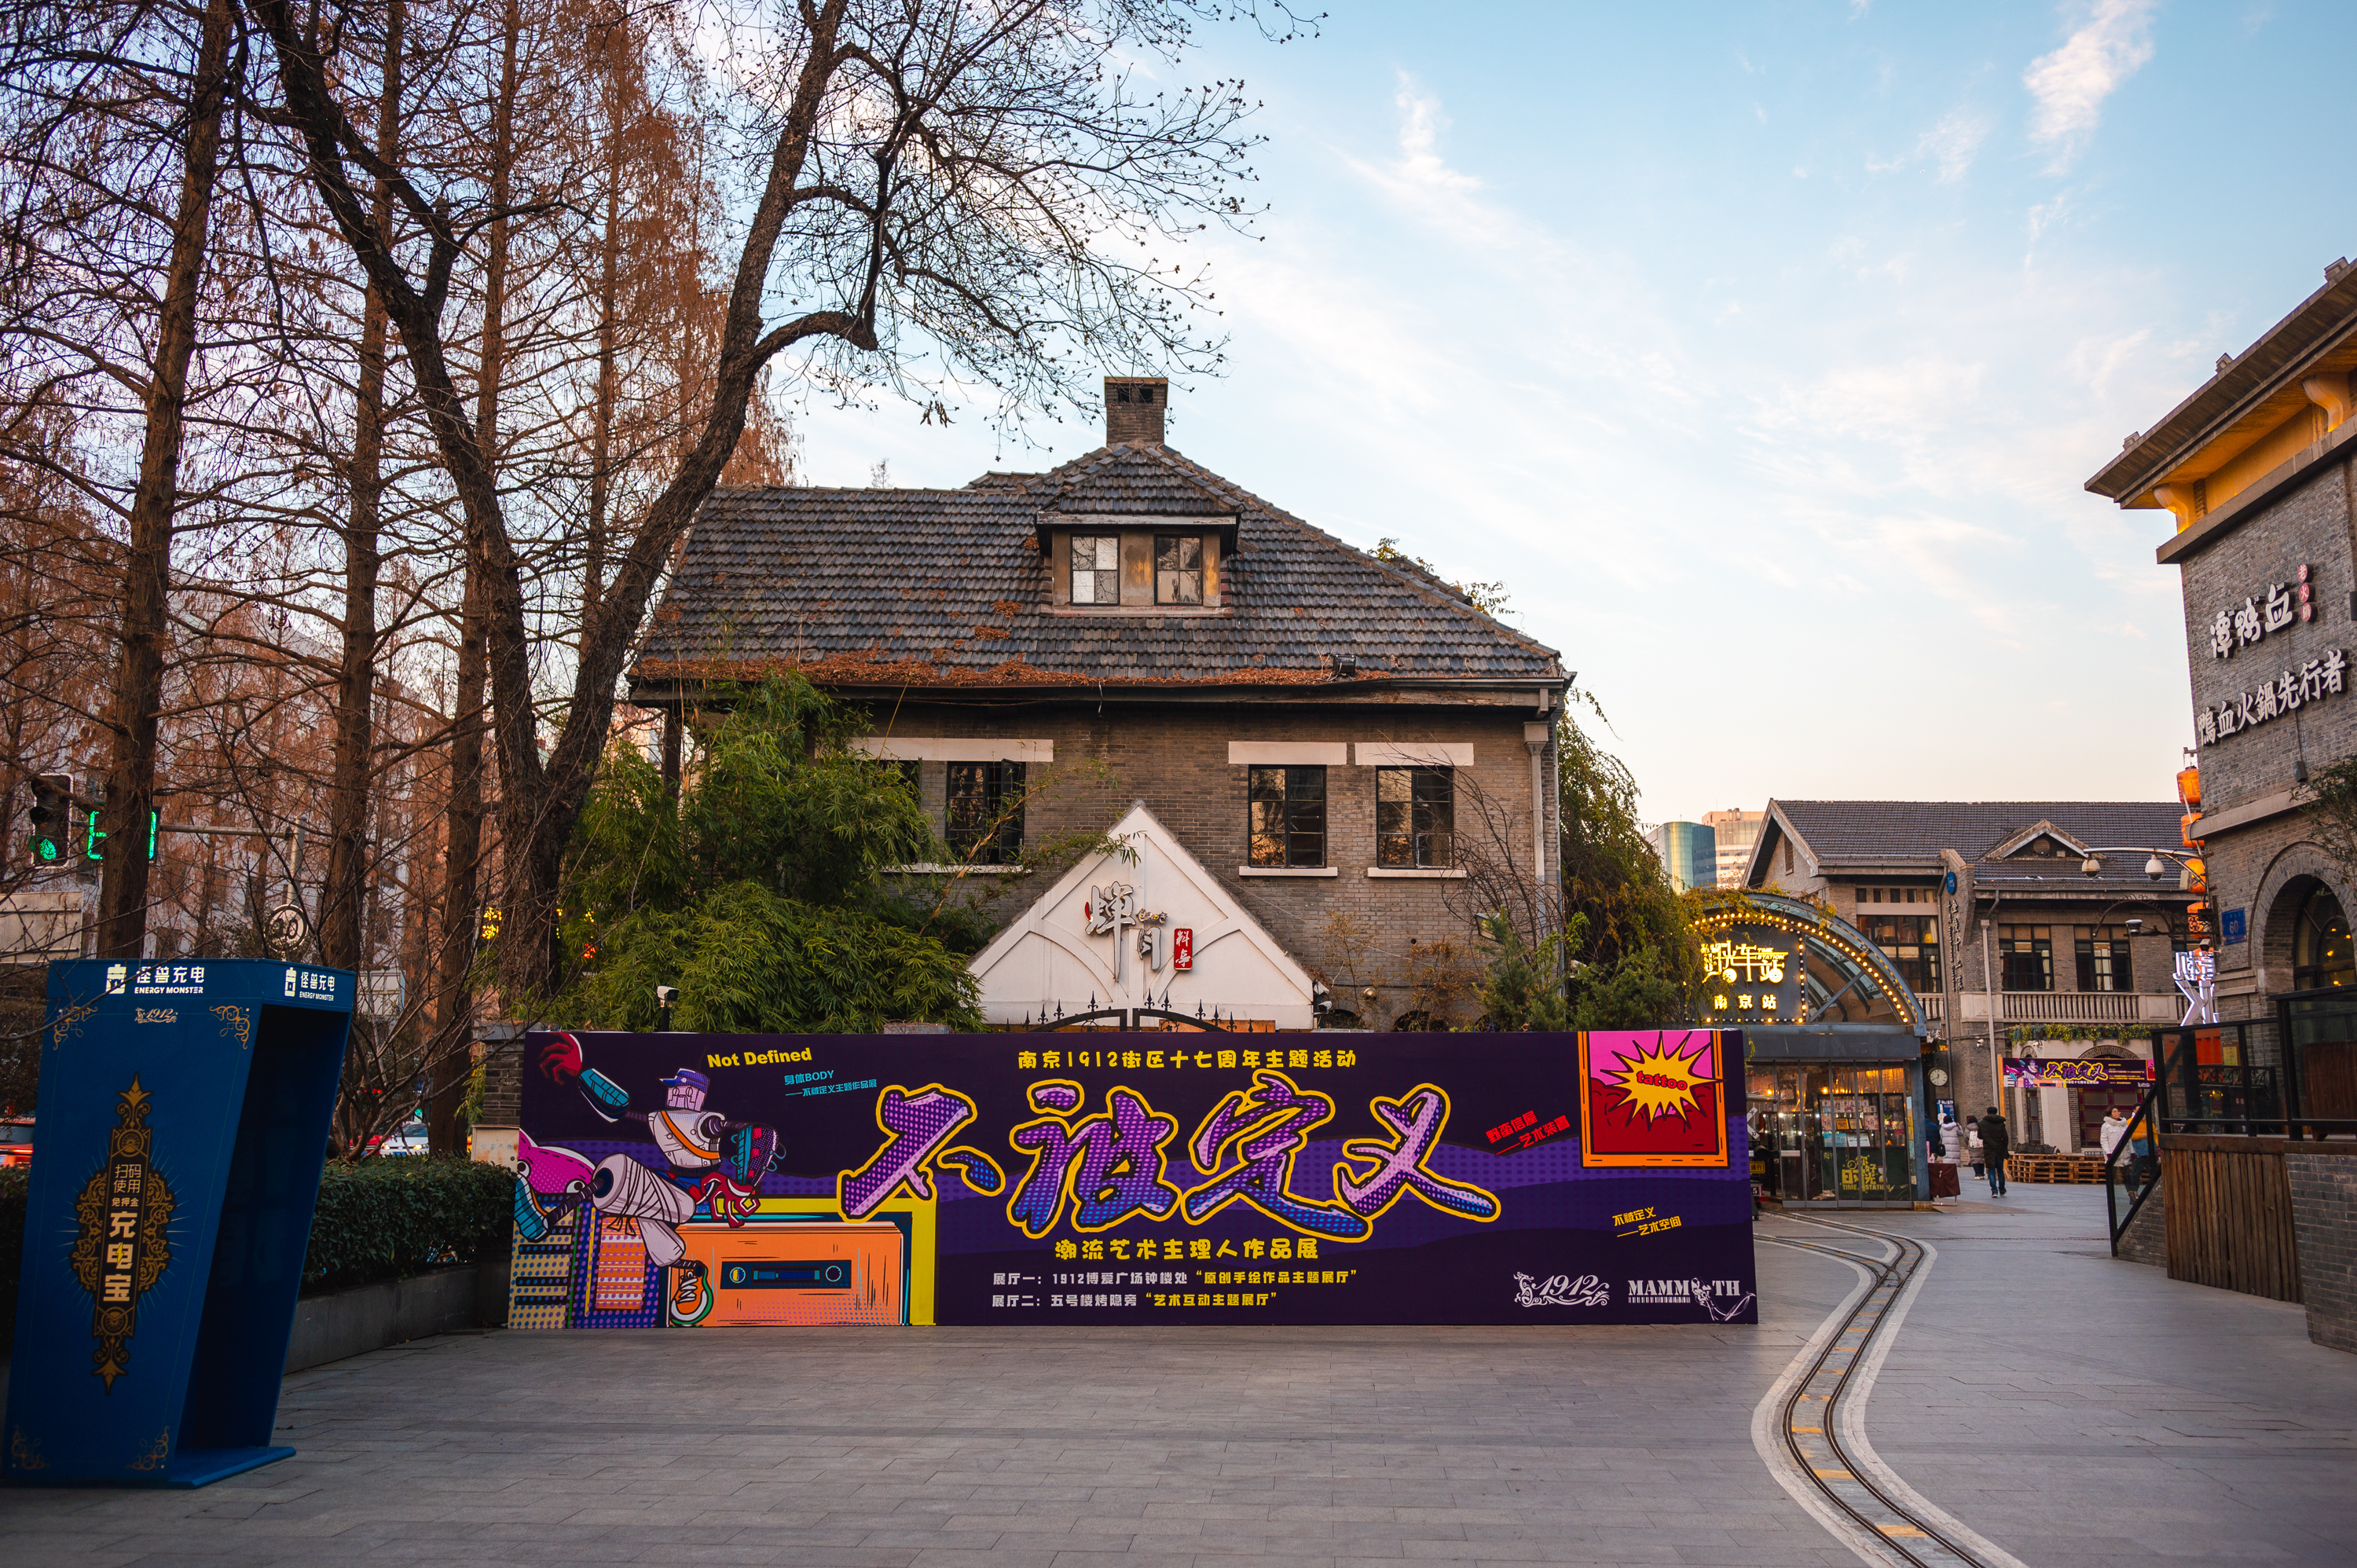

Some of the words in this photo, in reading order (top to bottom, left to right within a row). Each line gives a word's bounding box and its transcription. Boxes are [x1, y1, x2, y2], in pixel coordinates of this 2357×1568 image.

[2197, 649, 2346, 746] 鴨血火鍋先行者
[2230, 920, 2239, 934] 60
[136, 966, 204, 984] 怪兽充电
[300, 971, 335, 991] 怪兽充电
[299, 991, 316, 999] ENERGY
[317, 993, 334, 1002] MONSTER
[1714, 994, 1776, 1009] 南京站
[142, 1008, 178, 1020] 1912
[707, 1053, 740, 1068] Not
[744, 1047, 812, 1065] Defined
[1018, 1050, 1357, 1068] 南京1912街区十七周年主题活动
[784, 1070, 834, 1086] 身体BODY
[1637, 1071, 1688, 1090] tattoo
[838, 1068, 1501, 1240] 不被定义
[115, 1164, 141, 1178] 扫码
[113, 1179, 141, 1193] 使用
[112, 1197, 139, 1207] 免押金
[1612, 1207, 1657, 1226] 不被定义
[103, 1211, 137, 1302] 充电宝
[1054, 1238, 1318, 1260] 潮流艺术主理人作品展
[1532, 1273, 1610, 1298] 1912
[1628, 1279, 1741, 1297] MAMMTH
